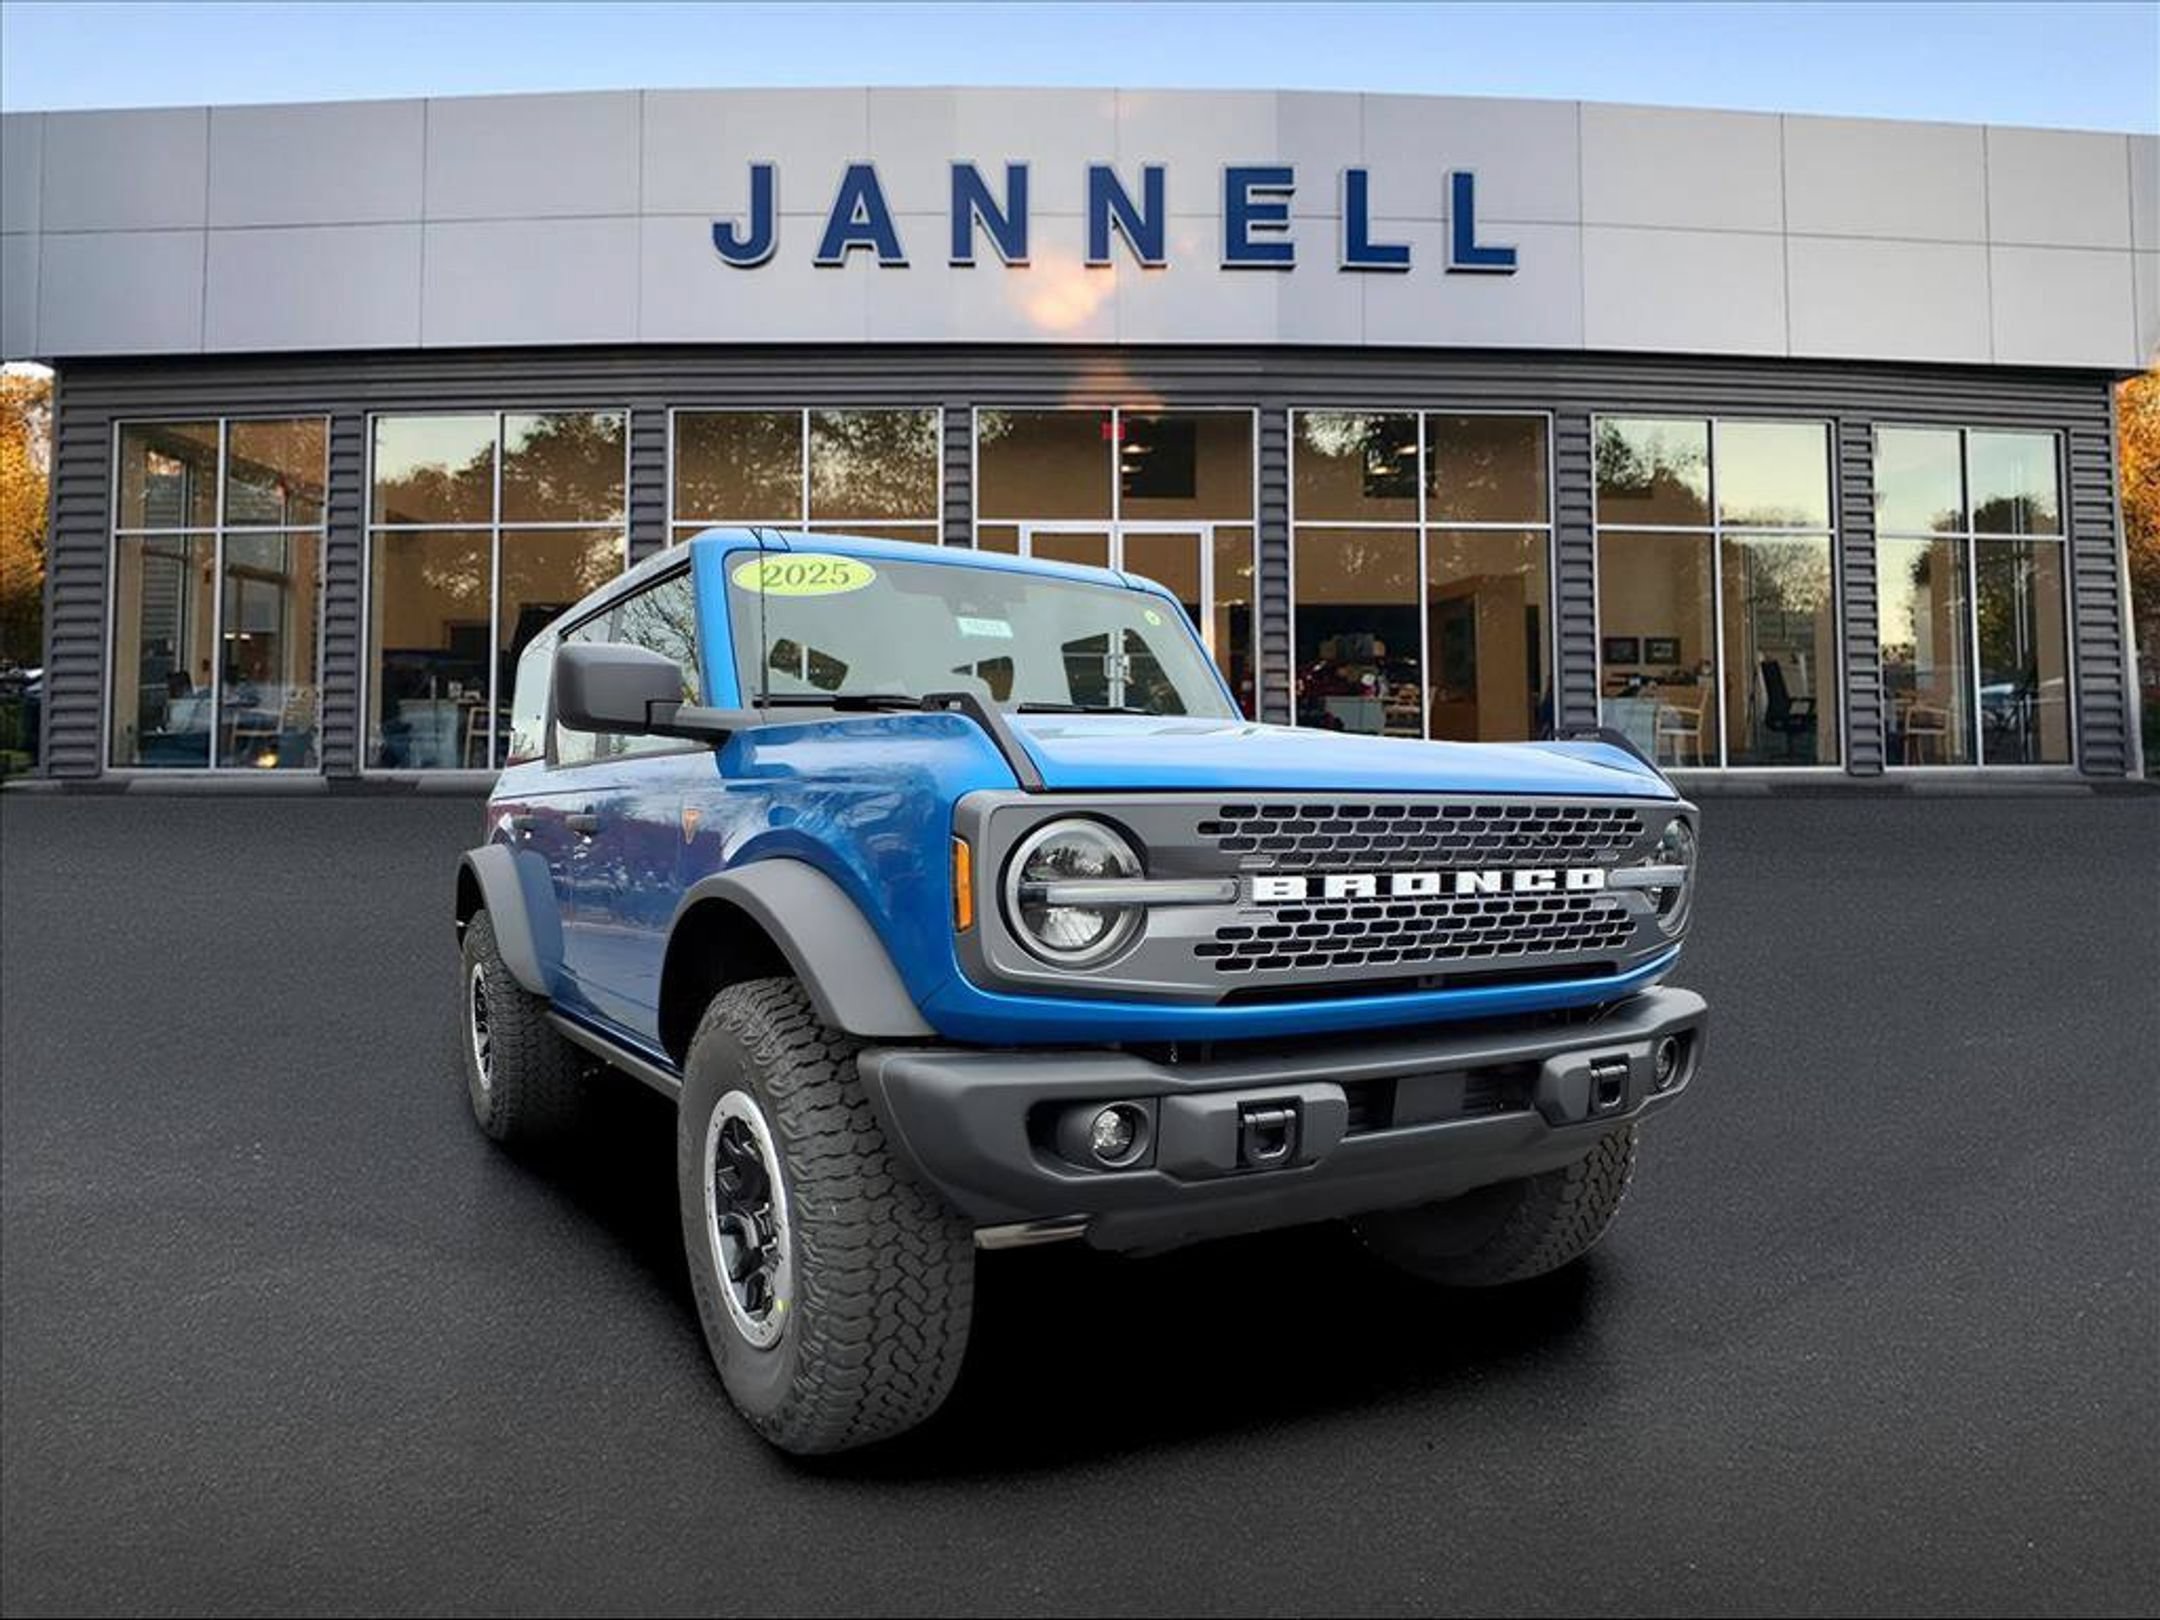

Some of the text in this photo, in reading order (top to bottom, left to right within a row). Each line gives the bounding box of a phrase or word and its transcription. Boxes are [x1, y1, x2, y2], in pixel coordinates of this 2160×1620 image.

[711, 162, 1518, 273] JANNELL
[761, 563, 850, 588] 2025
[1252, 868, 1605, 900] BRONCO
